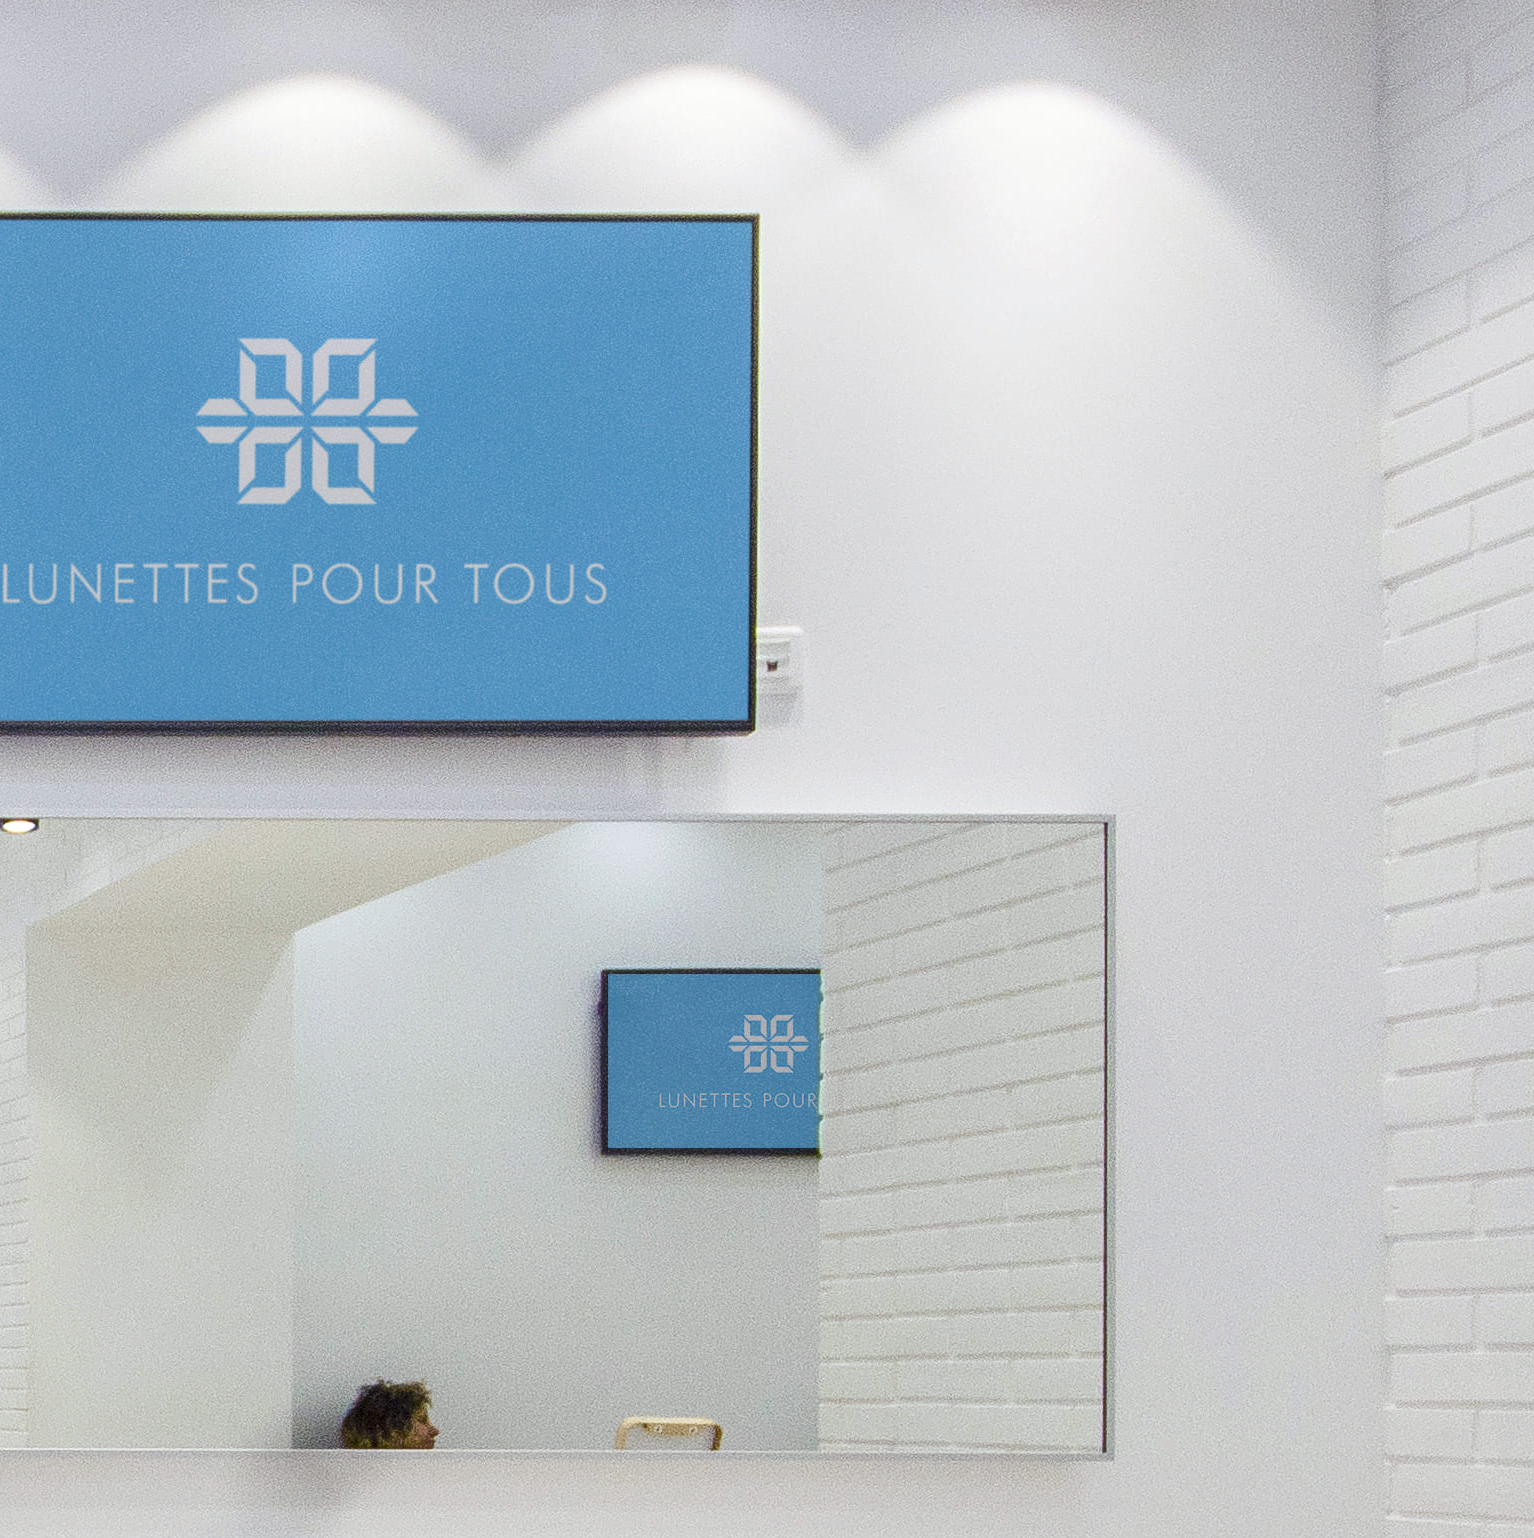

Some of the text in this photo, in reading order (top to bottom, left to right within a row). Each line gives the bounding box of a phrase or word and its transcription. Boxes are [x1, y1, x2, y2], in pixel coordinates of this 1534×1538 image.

[2, 562, 608, 605] LUNETTES POUR TOUS
[658, 1091, 818, 1109] LUNETTES POUR
